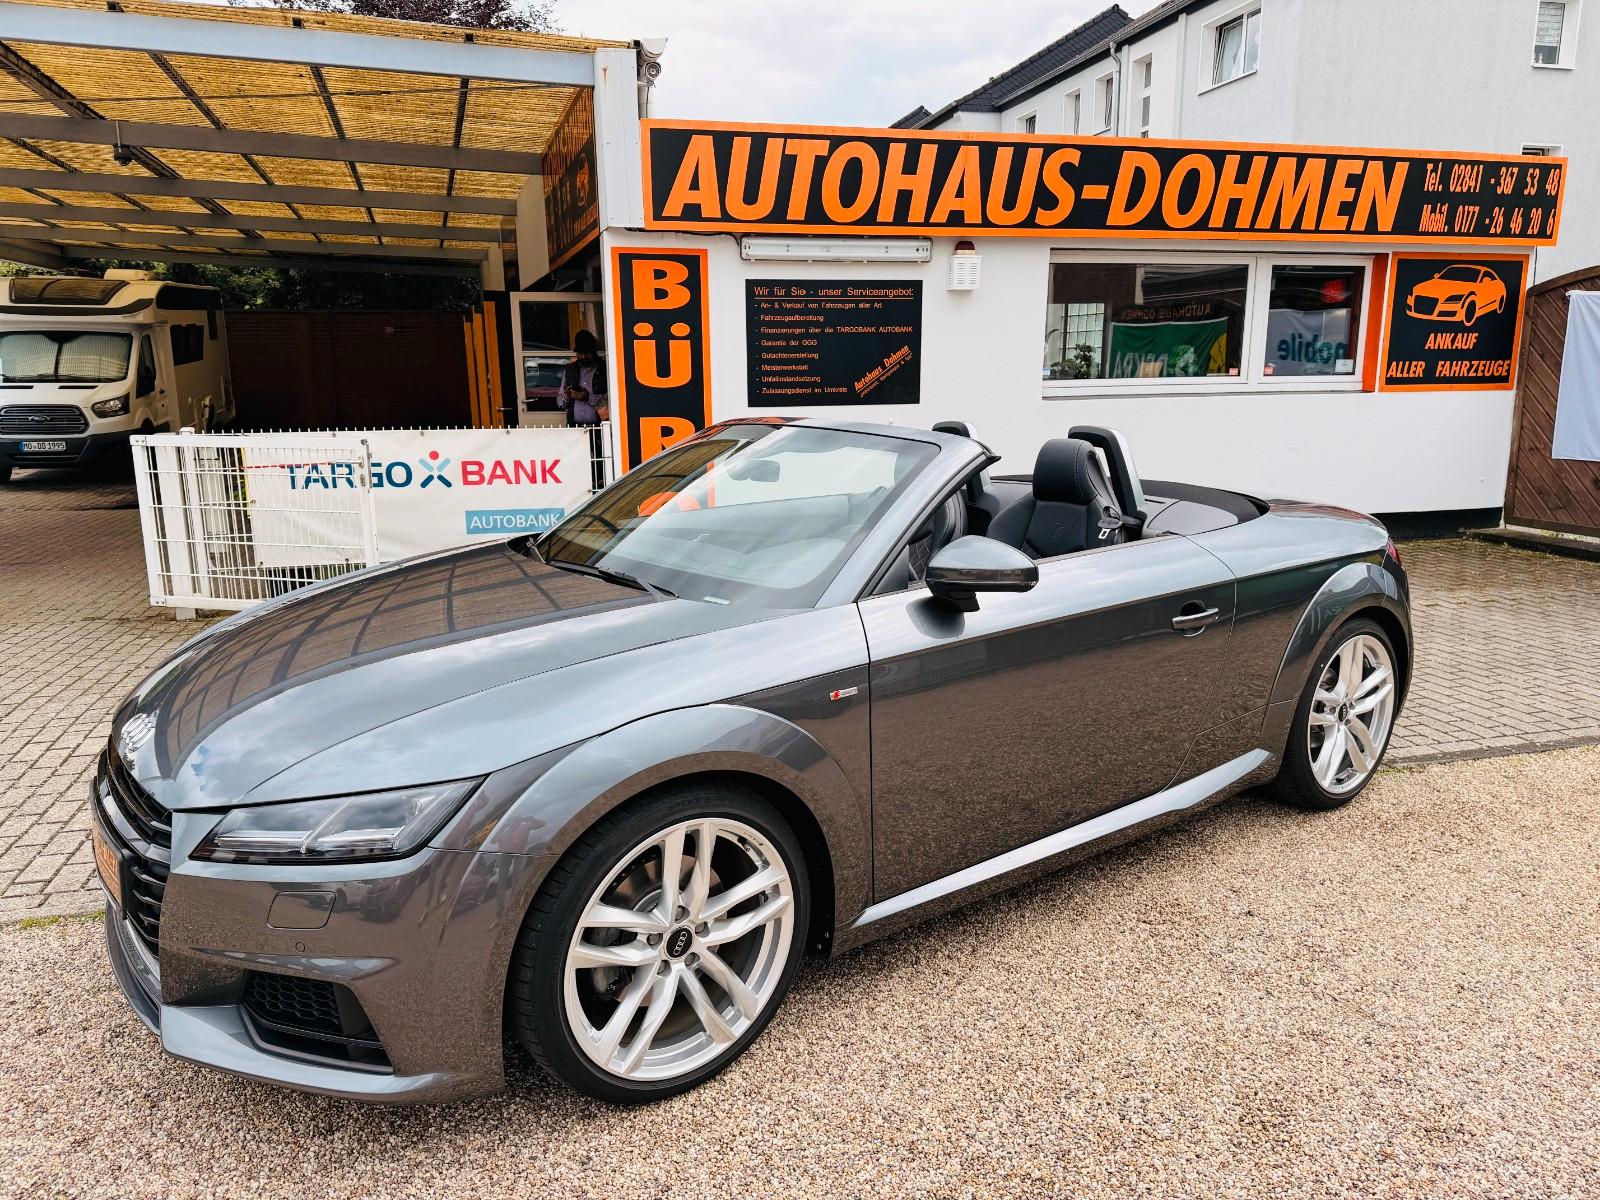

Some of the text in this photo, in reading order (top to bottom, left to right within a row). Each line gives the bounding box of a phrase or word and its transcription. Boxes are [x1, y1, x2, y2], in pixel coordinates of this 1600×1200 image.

[661, 134, 1410, 232] AUTOHAUS-DOHMEN
[1423, 161, 1443, 192] Tel.
[1449, 163, 1484, 193] 02841
[1524, 168, 1540, 196] 53
[1545, 168, 1561, 196] 48
[1418, 202, 1449, 233] Mobil.
[1454, 204, 1480, 233] 0177
[1509, 207, 1524, 235] 46
[1527, 207, 1542, 235] 20
[754, 286, 769, 296] Wir
[774, 286, 786, 296] für
[818, 287, 843, 296] unser
[847, 286, 914, 298] Serviceangebot:
[821, 302, 855, 310] Fahrzeugen
[760, 314, 824, 322] Fahrzeugaufbereitung
[760, 326, 806, 334] Finanzierungen
[1424, 332, 1479, 350] ANKAUF
[761, 352, 819, 360] Gutachtenerstellung
[854, 366, 883, 391] Autohaus
[883, 345, 910, 367] Dohmen
[1387, 359, 1511, 378] ALLER FAHRZEUGE
[761, 387, 812, 395] Zulassungsdienst
[460, 458, 562, 487] BANK
[470, 513, 561, 530] AUTOBANK
